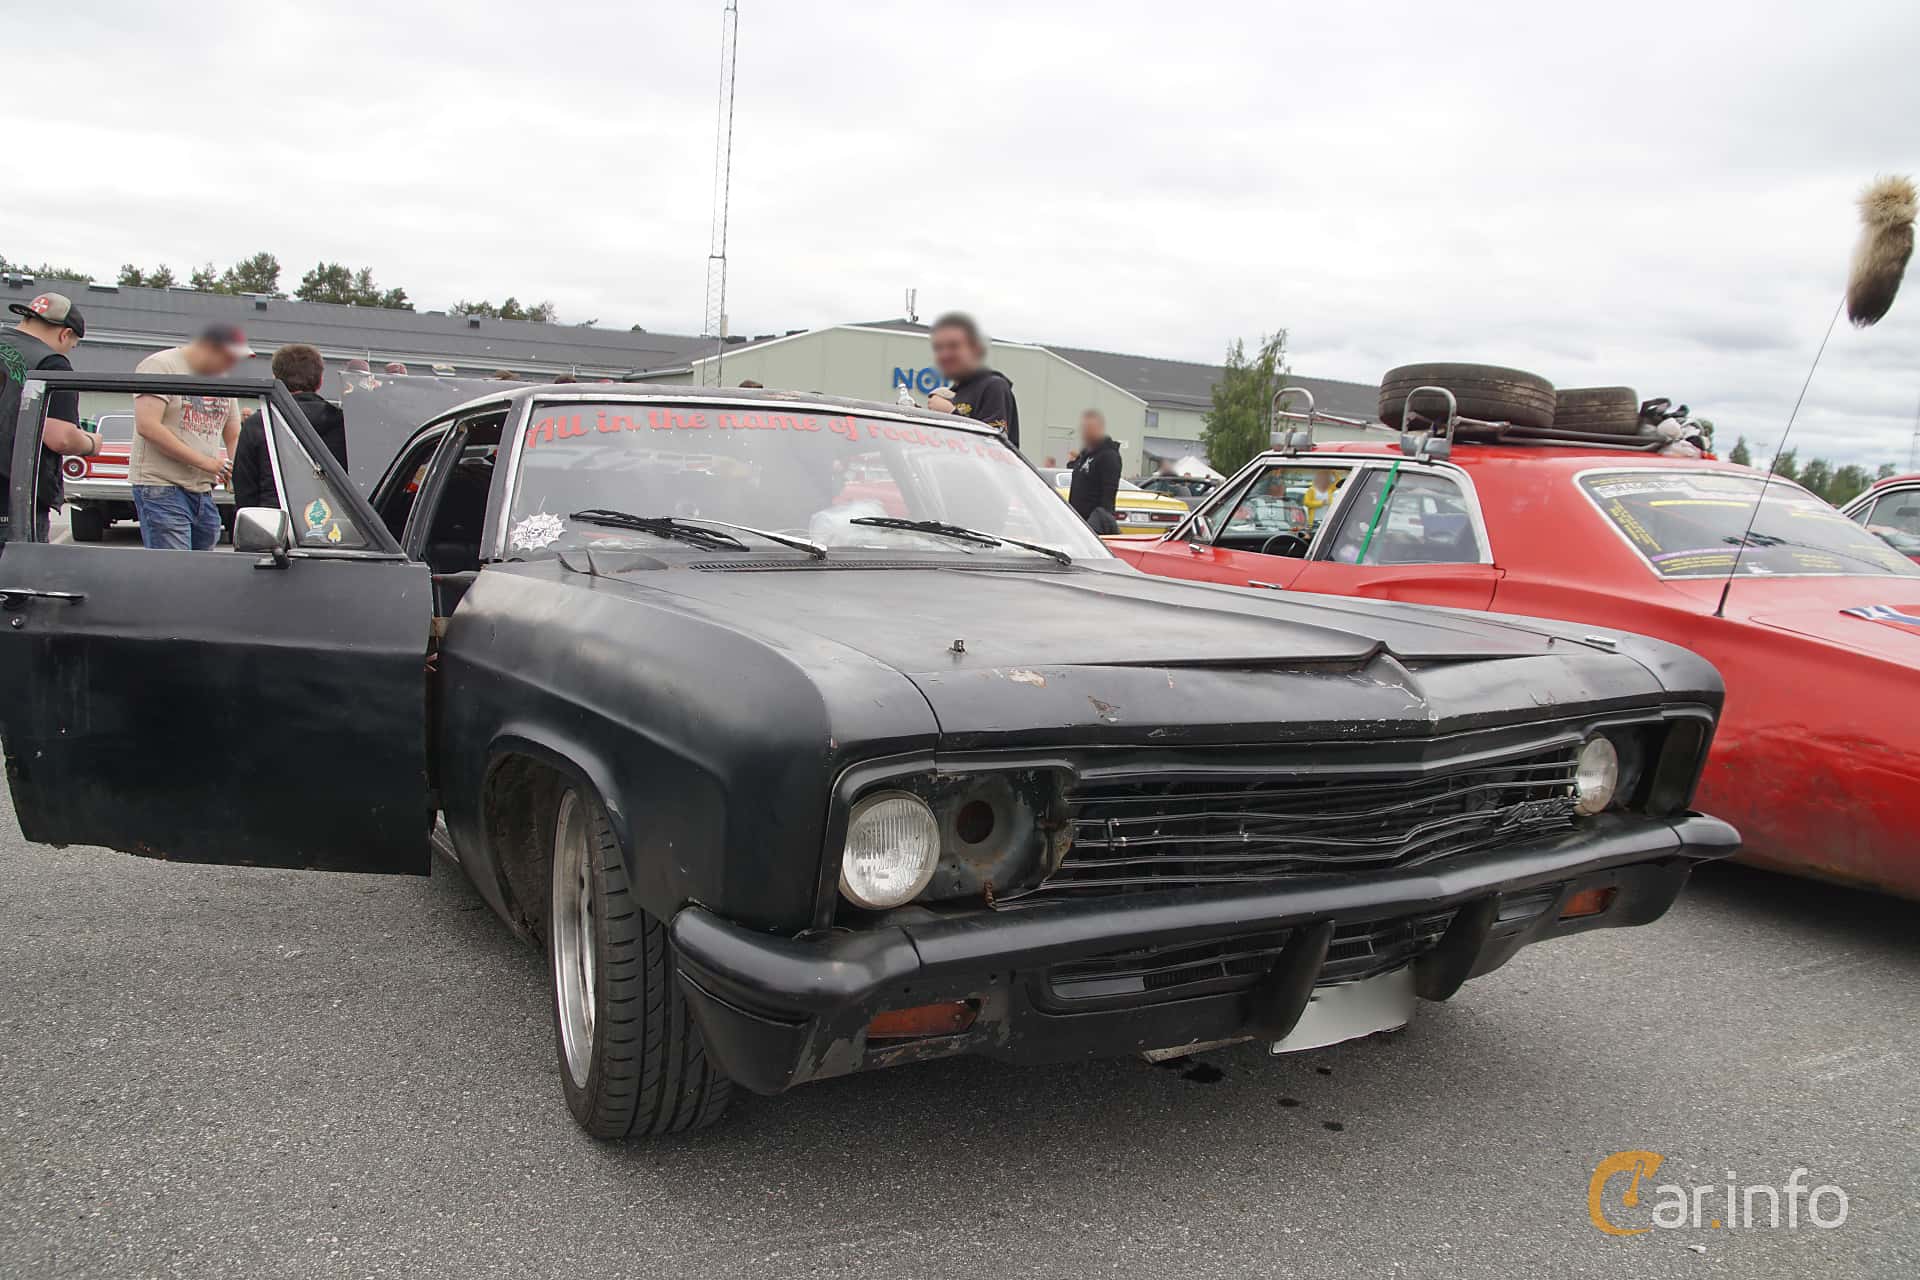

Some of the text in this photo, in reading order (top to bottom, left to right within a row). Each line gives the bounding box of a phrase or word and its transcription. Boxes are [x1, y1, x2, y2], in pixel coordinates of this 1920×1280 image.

[893, 367, 948, 394] NO
[527, 414, 588, 448] All
[597, 410, 640, 433] in
[647, 408, 709, 430] the
[718, 413, 823, 432] name
[828, 415, 859, 441] of
